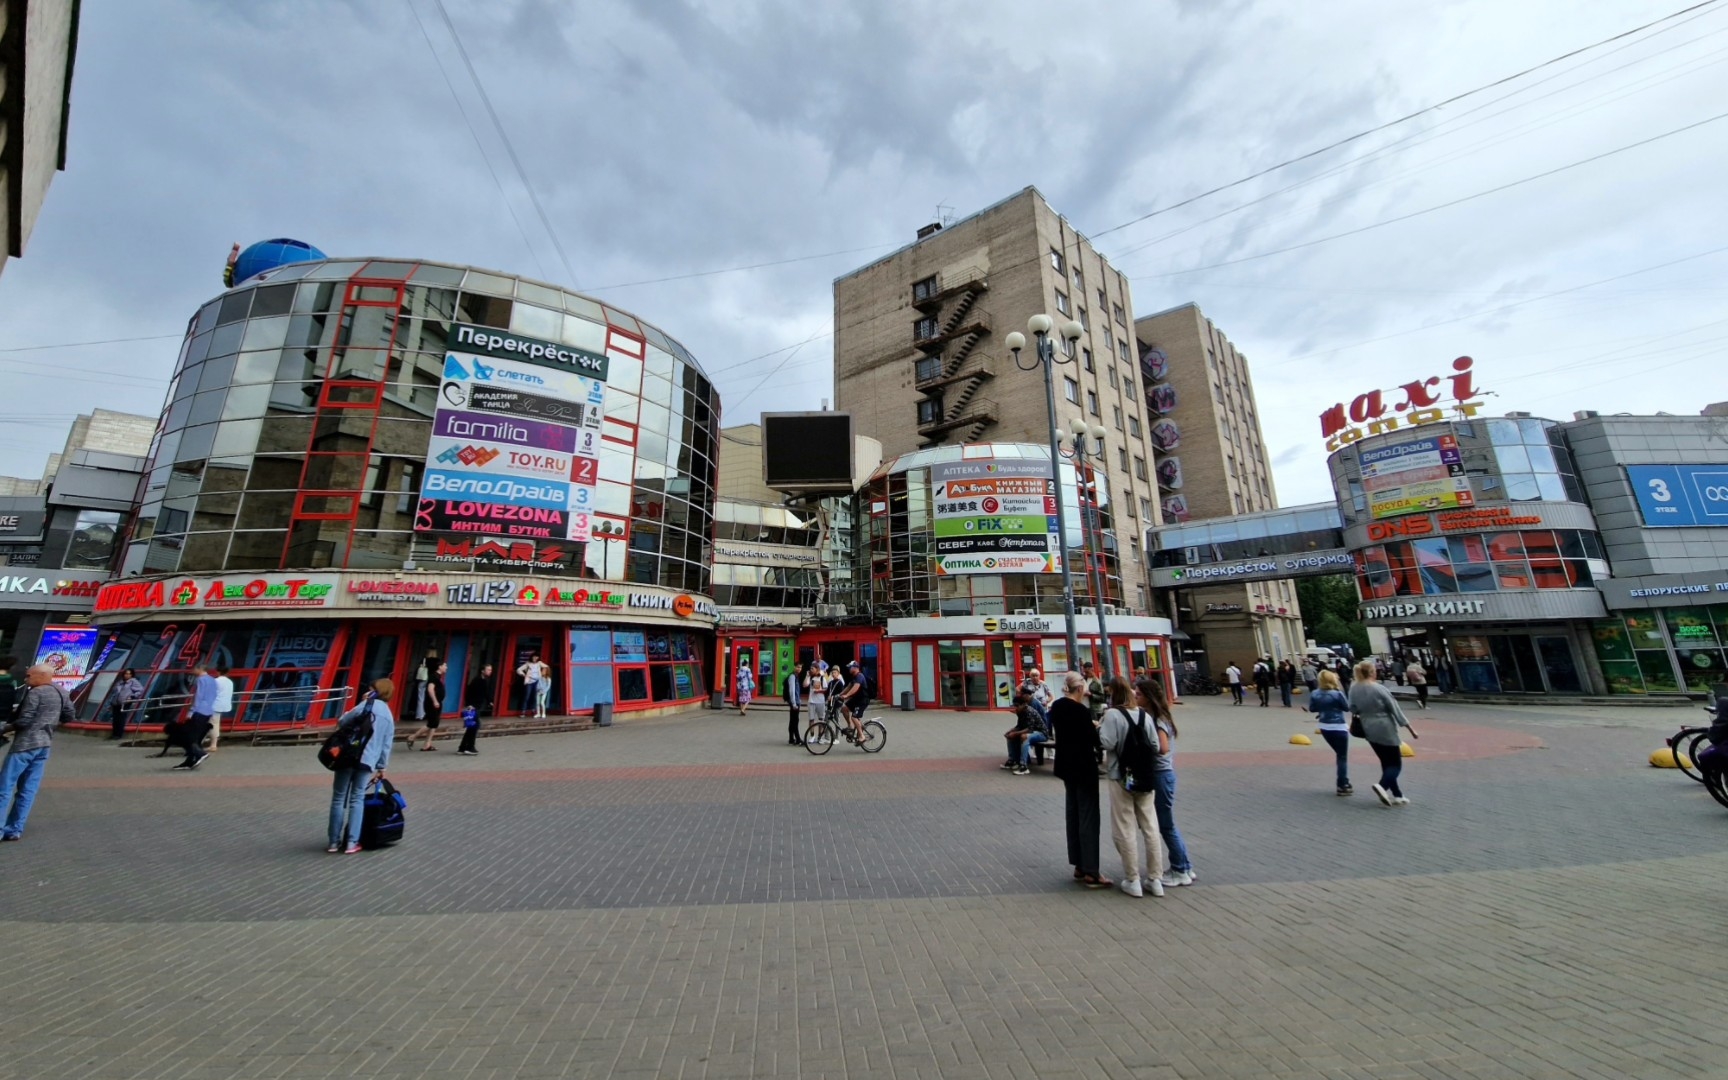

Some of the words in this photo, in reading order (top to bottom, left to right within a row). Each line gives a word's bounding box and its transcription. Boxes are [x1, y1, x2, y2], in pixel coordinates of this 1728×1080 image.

[497, 369, 545, 385] слетать
[593, 381, 601, 392] 5
[473, 392, 519, 401] АКАДЕМИЯ
[1320, 355, 1480, 438] maxi
[482, 401, 510, 409] ТАНЦА
[590, 407, 598, 418] 4
[447, 415, 528, 442] familia
[584, 432, 592, 447] 3
[1363, 441, 1433, 462] ВелоДрайв
[509, 451, 567, 471] TOY.RU
[579, 459, 592, 478] 2
[943, 466, 981, 476] АПТЕКА
[997, 465, 1016, 474] Будь
[426, 474, 565, 502] ВелоДрайв
[996, 486, 1043, 494] МАГАЗИН
[1047, 481, 1055, 490] 2
[1648, 478, 1671, 502] 3
[576, 488, 588, 504] 3
[1048, 498, 1056, 508] 3
[445, 500, 562, 525] LOVEZONA
[937, 501, 978, 514] 粥道美食
[1003, 504, 1028, 513] Буфет
[1371, 499, 1412, 512] ПОСУДА
[575, 512, 588, 529] 3
[1436, 508, 1499, 521] ЦИФРОВАЯ
[451, 521, 502, 533] ИНТИМ
[508, 524, 550, 537] БУТИК
[1367, 515, 1434, 541] DNS
[1440, 519, 1491, 530] БЫТОВАЯ
[1495, 516, 1542, 526] ТЕХНИКА
[938, 540, 974, 550] СЕВЕР
[435, 555, 488, 564] ПЛАНЕТА
[492, 558, 565, 570] КИБЕРСПОРТА
[944, 560, 982, 569] ОПТИКА
[347, 580, 440, 595] LOVEZONA
[447, 579, 517, 606] TELE2
[1630, 584, 1710, 598] БЕЛОРУССКИЕ
[95, 581, 164, 612] АПТЕКА
[629, 593, 673, 609] КНИГИ
[1366, 604, 1418, 620] БУРГЕР
[1424, 599, 1485, 616] КИНГ
[999, 617, 1050, 631] Билайн
